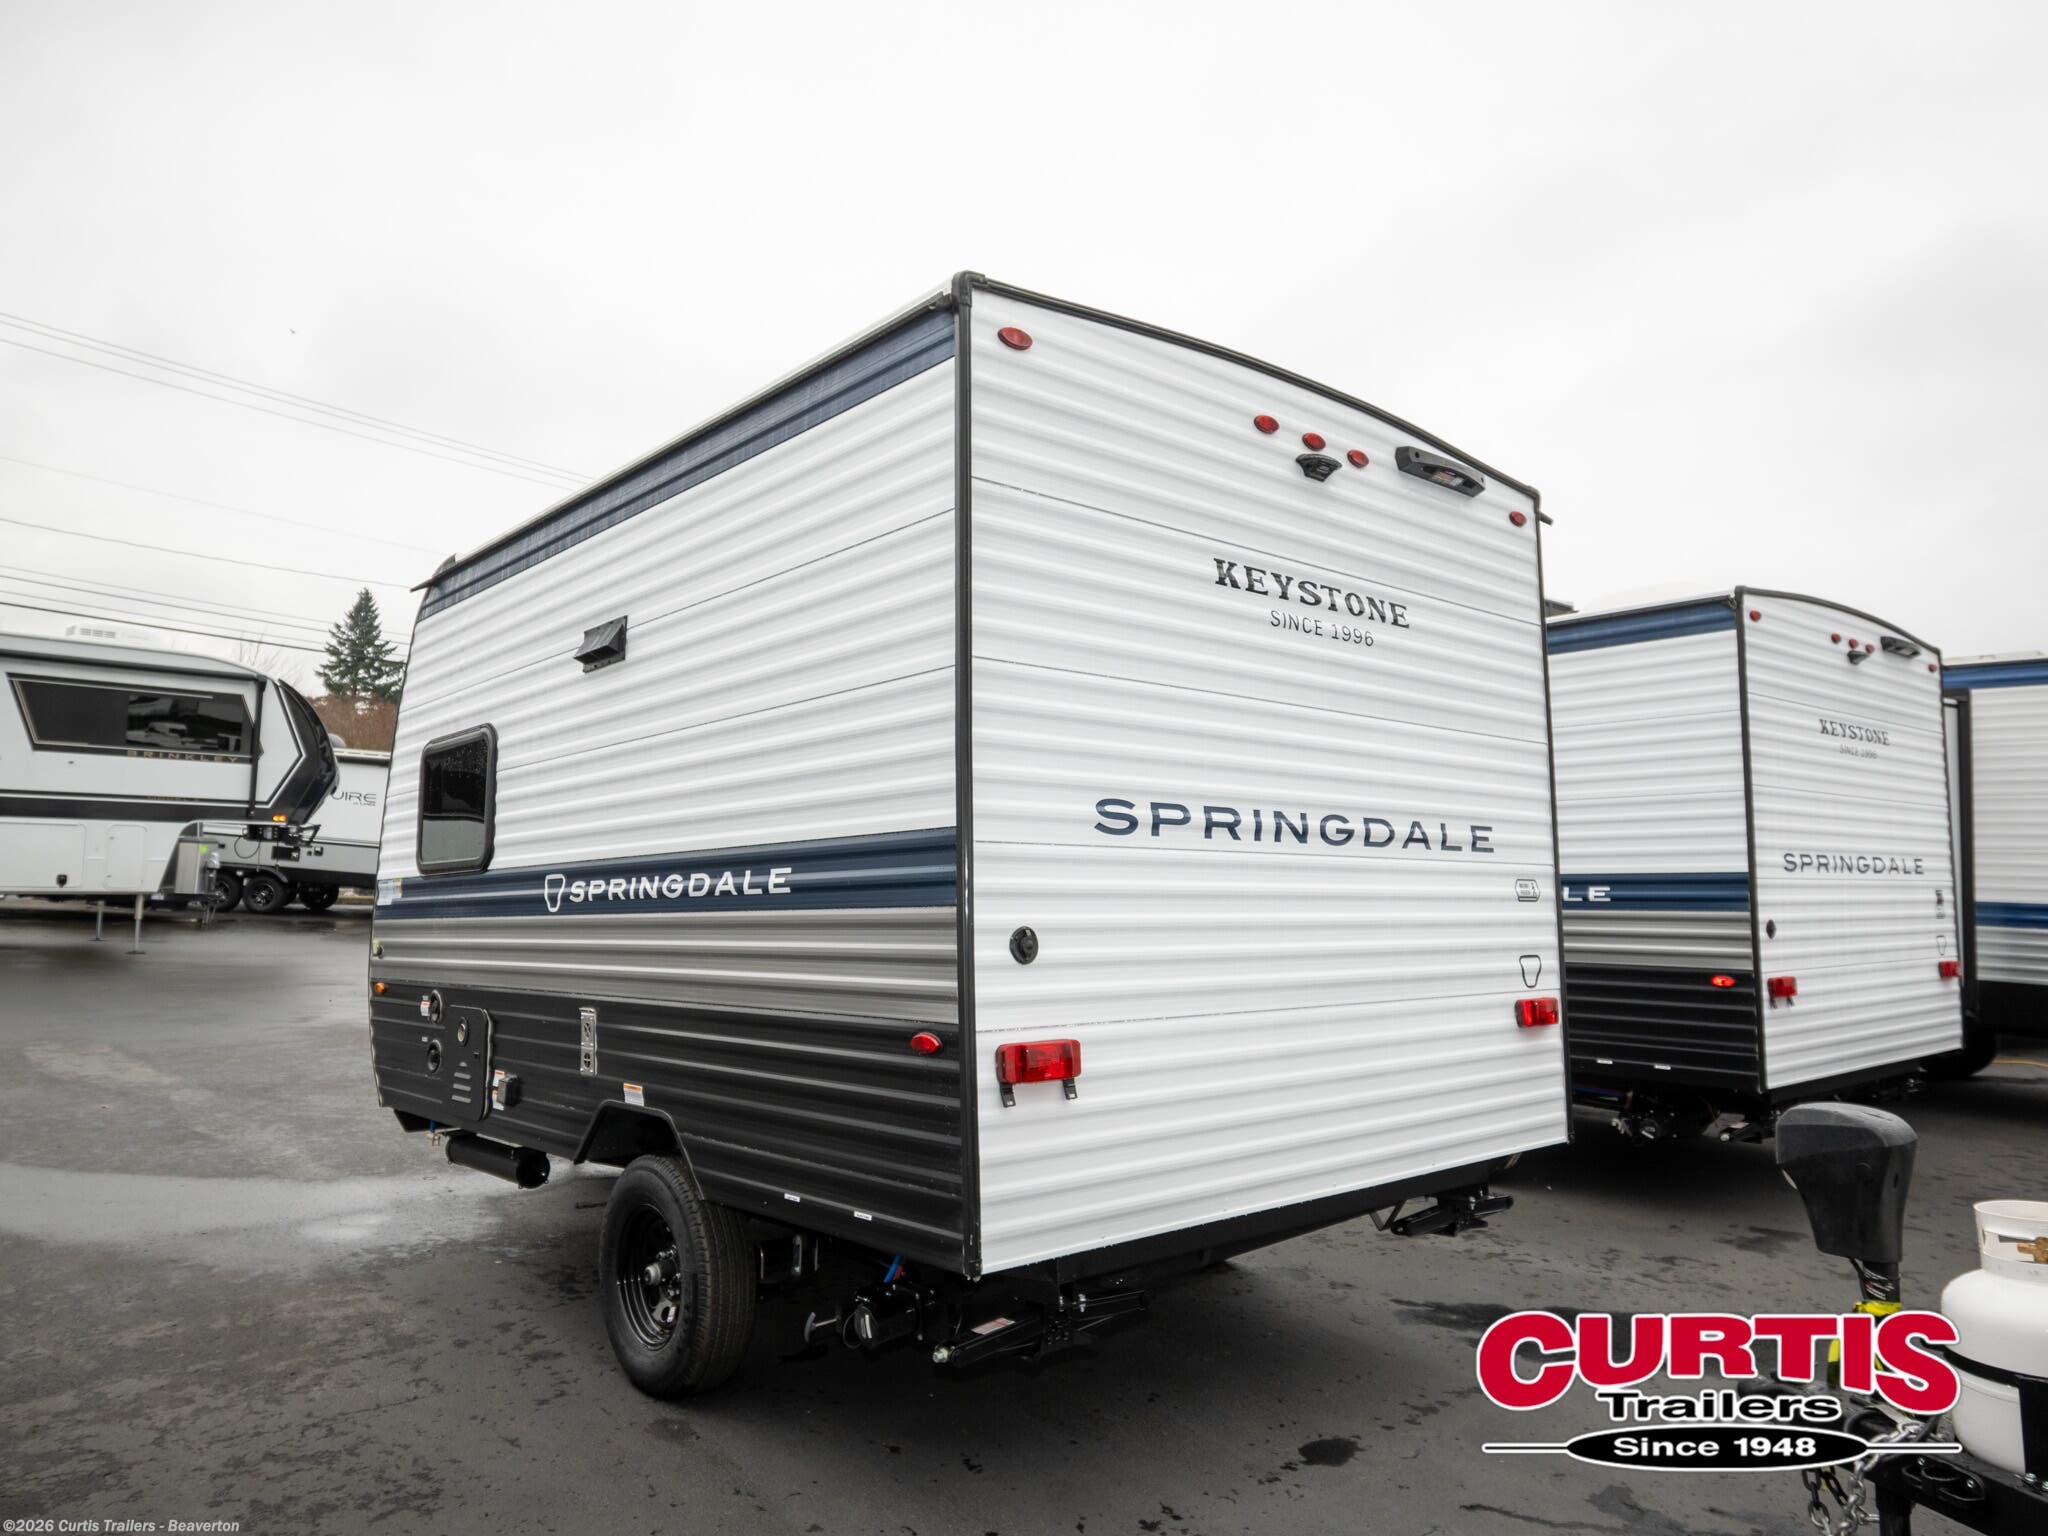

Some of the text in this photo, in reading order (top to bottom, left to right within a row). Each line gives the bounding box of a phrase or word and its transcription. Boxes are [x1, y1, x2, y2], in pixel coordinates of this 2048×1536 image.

[1213, 558, 1410, 629] KEYSTONE
[1271, 610, 1374, 647] SINCE 1996
[1819, 718, 1890, 746] KEYSTONE
[1094, 798, 1495, 853] SPRINGDALE
[1783, 853, 1925, 875] SPRINGDALE
[569, 867, 793, 903] SPRINGDALE
